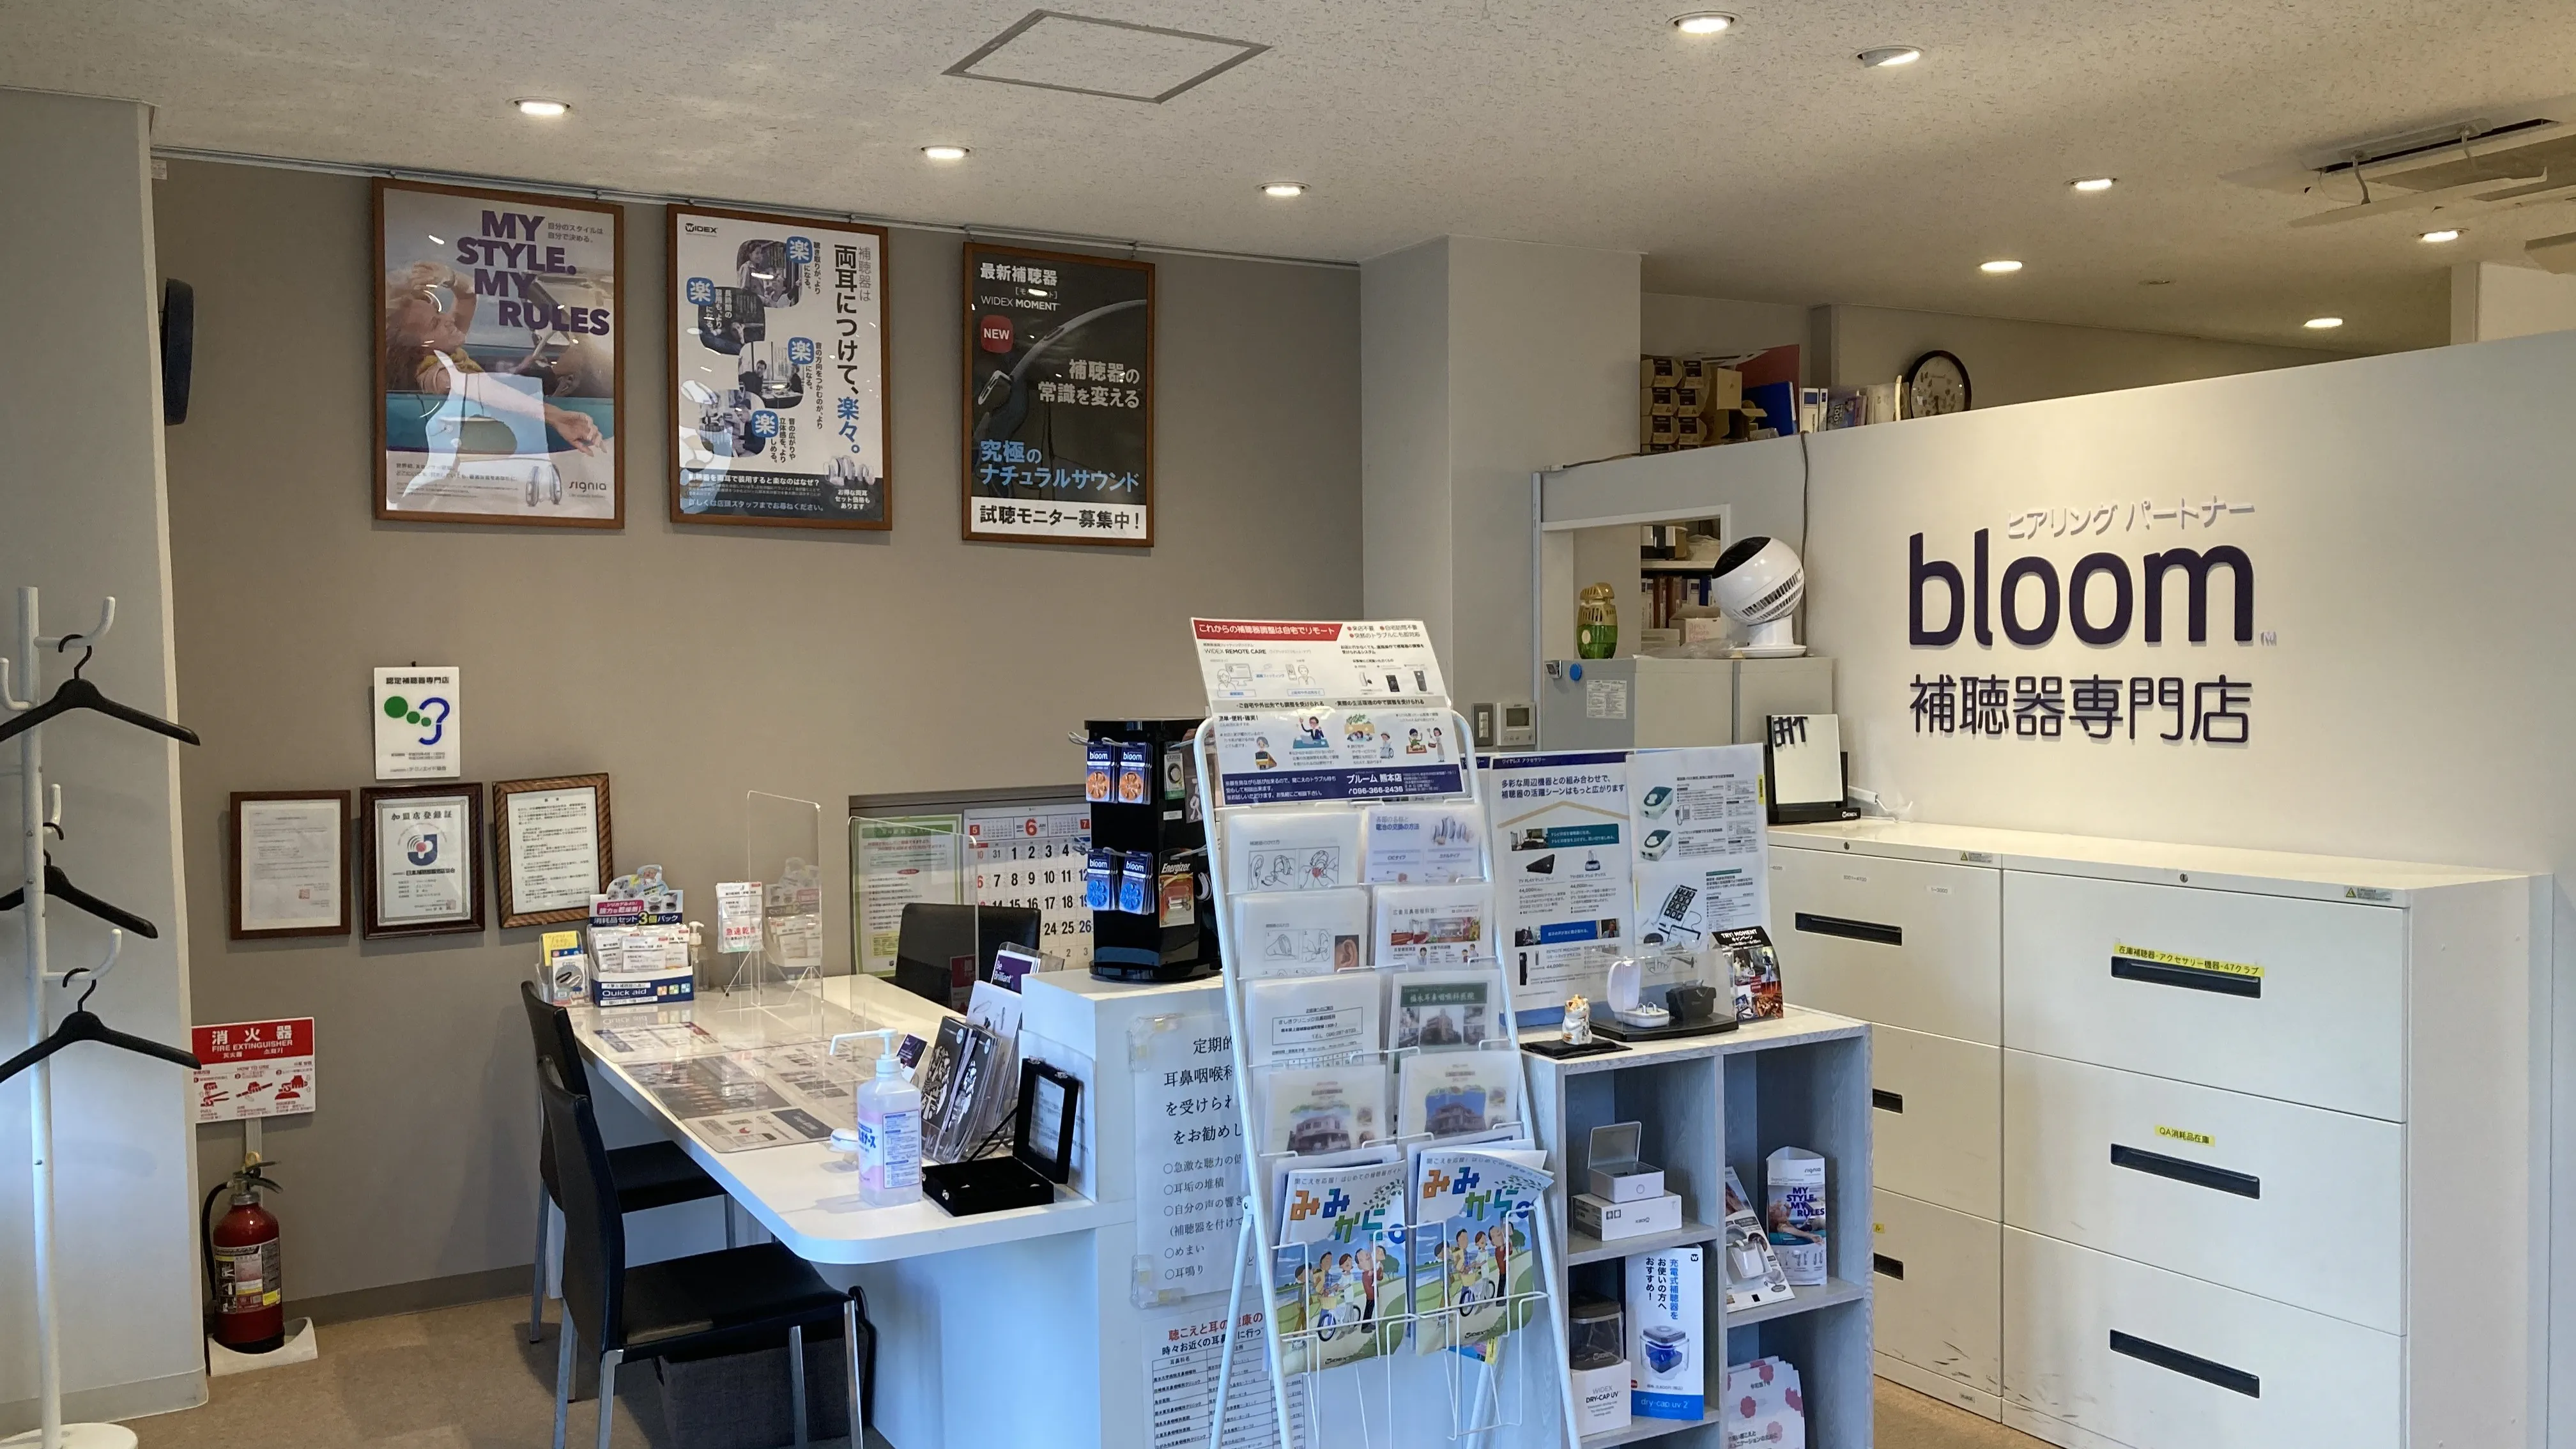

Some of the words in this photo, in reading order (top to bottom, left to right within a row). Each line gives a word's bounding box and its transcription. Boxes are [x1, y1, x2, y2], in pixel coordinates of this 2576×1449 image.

[482, 210, 544, 241] MY
[548, 222, 603, 234] 自分のスタイルは
[686, 223, 718, 233] WIDEX
[456, 237, 577, 274] STYLE.
[790, 240, 809, 261] 楽
[475, 268, 536, 299] MY
[858, 247, 871, 302] 補聴器は
[981, 262, 1058, 286] 最新補聴器
[690, 281, 710, 302] 楽
[981, 295, 1013, 307] WIDEX
[1015, 298, 1059, 312] MOMENT
[499, 300, 610, 336] RULES
[983, 328, 1010, 341] NEW
[792, 341, 811, 362] 楽
[834, 244, 861, 455] 両耳につけて、楽々。
[1069, 358, 1139, 384] 補聴器の
[1038, 381, 1139, 408] 常識を変える
[755, 413, 775, 434] 楽
[981, 439, 1042, 464] 究極の
[569, 480, 607, 492] signia
[980, 465, 1139, 493] ナチュラルサウンド
[980, 505, 1140, 530] 試聴モニター募集中！
[2009, 503, 2117, 540] ヒアリング
[2127, 496, 2255, 531] パートナー
[1909, 528, 2255, 647] bloom
[1199, 624, 1335, 635] これからの補聴器調整は自宅でリモート
[386, 677, 449, 685] 認定補聴器専門店
[1909, 673, 2253, 744] 補聴器専門店
[1089, 751, 1108, 760] bloom
[1123, 752, 1142, 761] bloom
[1346, 774, 1377, 785] ブルーム
[1380, 773, 1402, 783] 熊本店
[1501, 775, 1610, 788] 多彩な周辺機器との組み合わせで、
[1501, 784, 1625, 799] 補聴器の活躍シーンはもっと広がります
[1025, 818, 1038, 836] 6
[1011, 848, 1016, 859] 1
[1028, 847, 1036, 859] 2
[1045, 845, 1053, 857] 3
[1062, 844, 1069, 856] 4
[1089, 858, 1108, 868] bloom
[1126, 861, 1145, 871] bloom
[1162, 861, 1190, 873] Energizer
[977, 875, 983, 888] 6
[994, 874, 1000, 887] 7
[1011, 873, 1018, 886] 8
[1028, 872, 1035, 884] 9
[1045, 871, 1055, 884] 10
[1061, 870, 1071, 882] 11
[1027, 898, 1038, 909] 16
[1045, 897, 1055, 909] 17
[1062, 896, 1073, 908] 18
[1044, 923, 1057, 935] 24
[1062, 921, 1074, 934] 25
[1079, 920, 1092, 933] 26
[212, 1025, 292, 1045] 消火器
[212, 1044, 230, 1052] FIRE
[233, 1039, 293, 1050] EXTINGUISHER
[2159, 1126, 2209, 1144] QA消耗品在庫
[1423, 1167, 1480, 1198] みみ
[1291, 1188, 1350, 1220] みみ
[1797, 1208, 1825, 1217] RULES
[1645, 1257, 1655, 1301] おすすめ！
[1657, 1258, 1667, 1310] お使いの方へ
[1669, 1258, 1679, 1320] 充電式補聴器を
[1169, 1312, 1263, 1341] 聴こえと耳の康の
[1586, 1393, 1609, 1404] DRY-CAP
[1593, 1385, 1613, 1395] WIDEX
[1641, 1398, 1670, 1409] dry-cap
